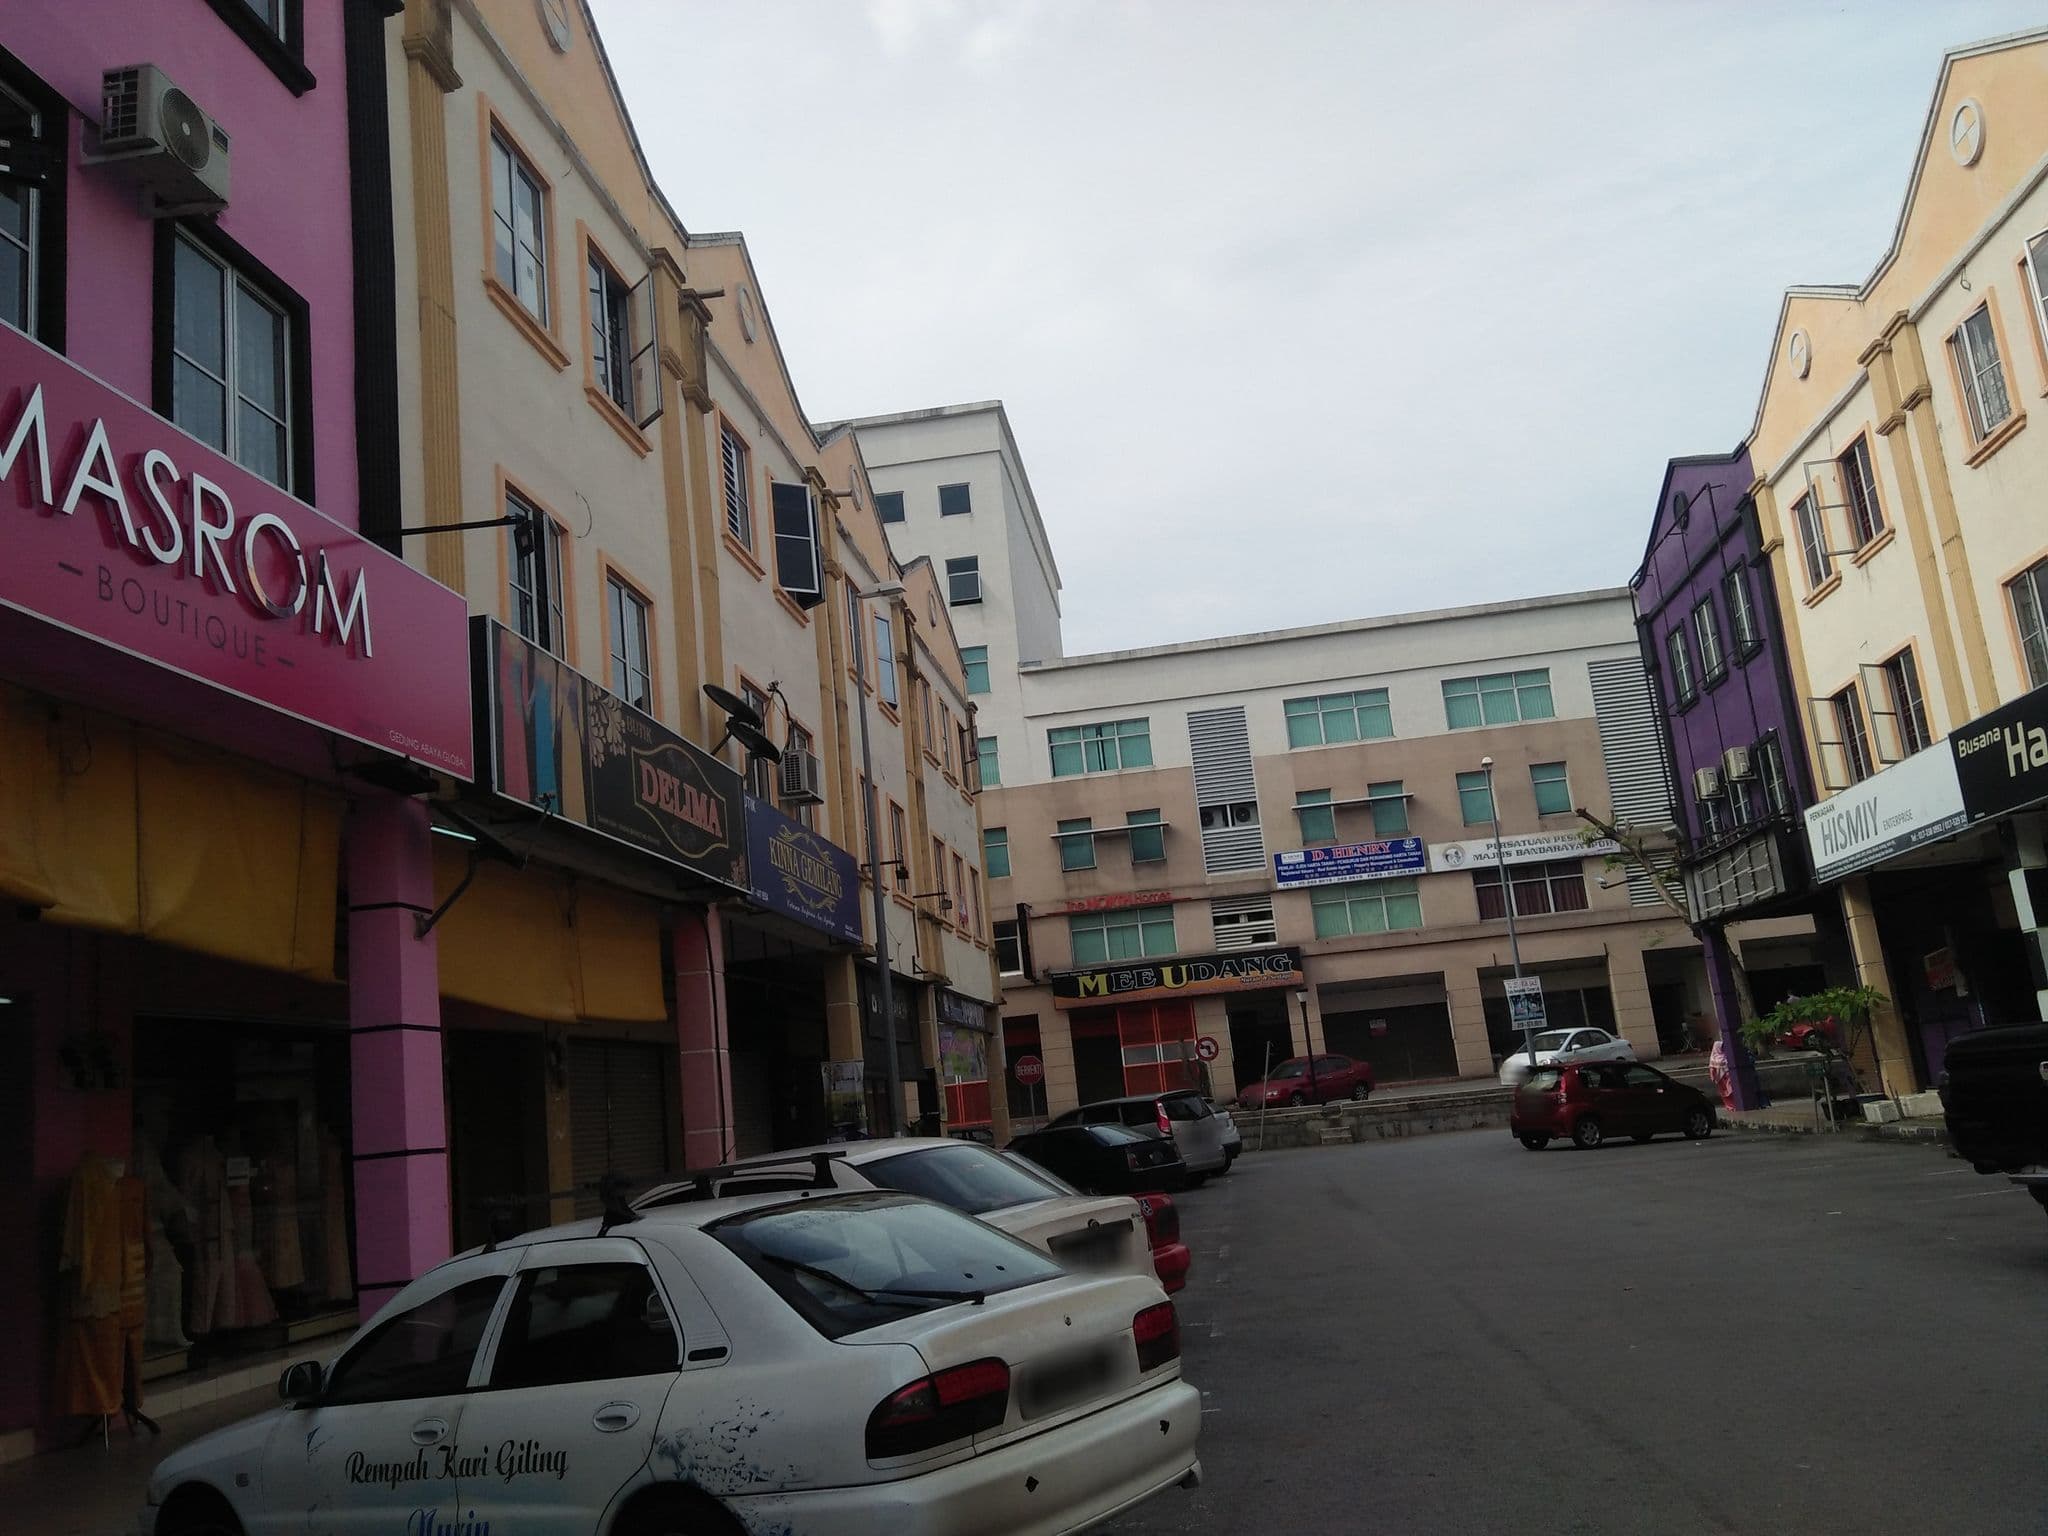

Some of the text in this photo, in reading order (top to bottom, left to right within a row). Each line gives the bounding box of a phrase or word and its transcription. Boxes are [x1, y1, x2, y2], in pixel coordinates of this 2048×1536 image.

[0, 383, 373, 658] MASROM
[97, 565, 267, 668] BOUTIQUE
[1958, 727, 2001, 758] Busana
[639, 758, 723, 839] DELIMA
[1882, 808, 1913, 831] ENTERPRISE
[1332, 843, 1392, 860] HENRY
[1516, 840, 1584, 857] BANDARAYA
[1820, 796, 1878, 857] HISMIY
[769, 837, 843, 898] KINNA GEMILANG
[1077, 968, 1158, 998] MEE
[1160, 953, 1295, 990] UDANG
[345, 1439, 570, 1489] Rempah Kari Giling
